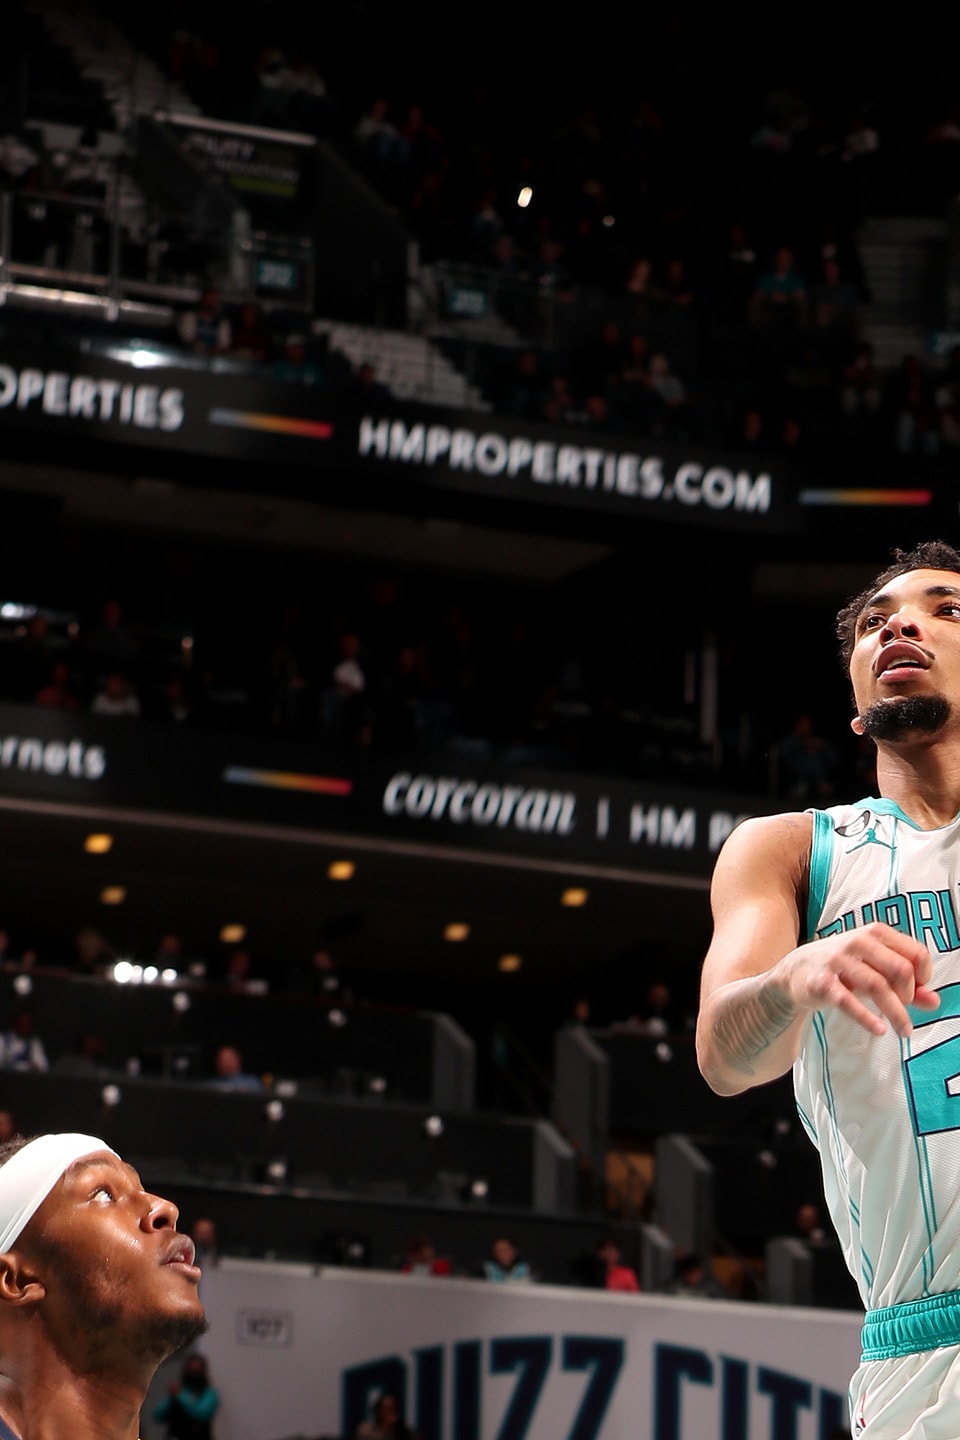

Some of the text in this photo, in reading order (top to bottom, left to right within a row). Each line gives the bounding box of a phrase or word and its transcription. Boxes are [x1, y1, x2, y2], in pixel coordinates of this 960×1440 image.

[359, 417, 771, 512] HMPROPERTIES.COM
[382, 772, 575, 835] corcoran
[629, 800, 697, 850] HM
